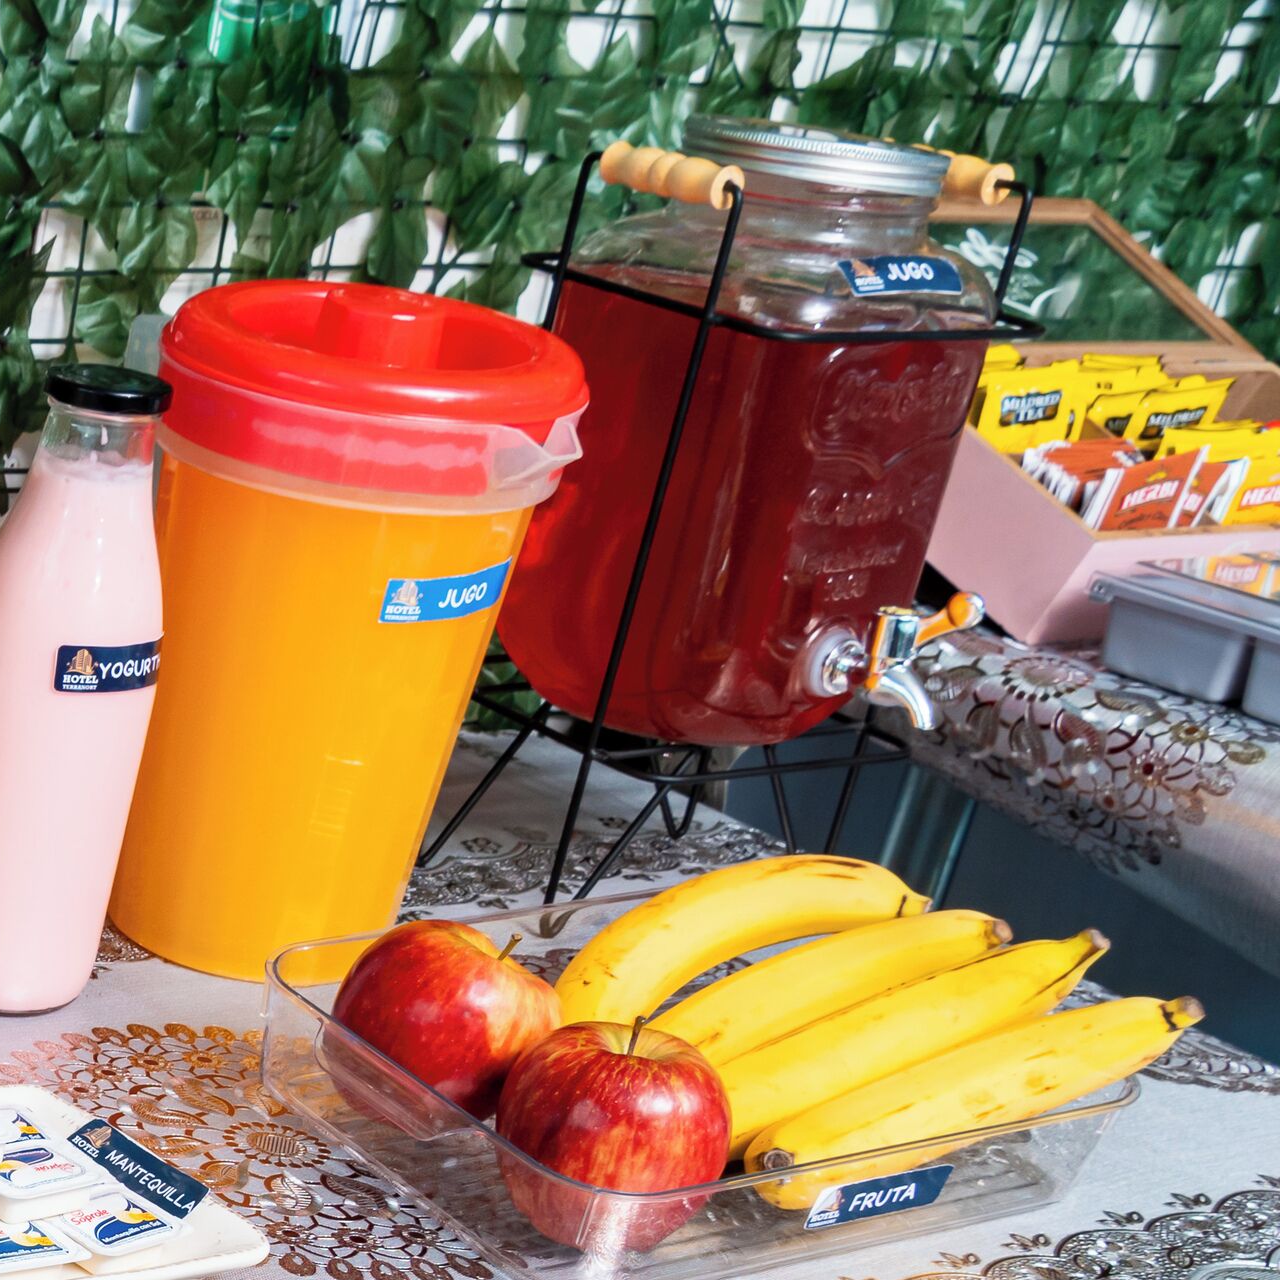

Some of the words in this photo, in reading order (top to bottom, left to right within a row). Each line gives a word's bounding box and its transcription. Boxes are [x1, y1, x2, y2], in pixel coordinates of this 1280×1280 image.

[887, 261, 934, 281] JUGO
[1002, 391, 1061, 413] MILDRED
[1017, 407, 1044, 422] TEA
[1121, 480, 1179, 510] HERBI
[438, 582, 488, 608] JUGO
[385, 605, 422, 615] HOTEL
[62, 674, 99, 684] HOTEL
[71, 1135, 100, 1158] HOTEL
[105, 1149, 196, 1213] MANTEQUILLA
[848, 1183, 916, 1212] FRUTA
[70, 1208, 110, 1225] Soprole
